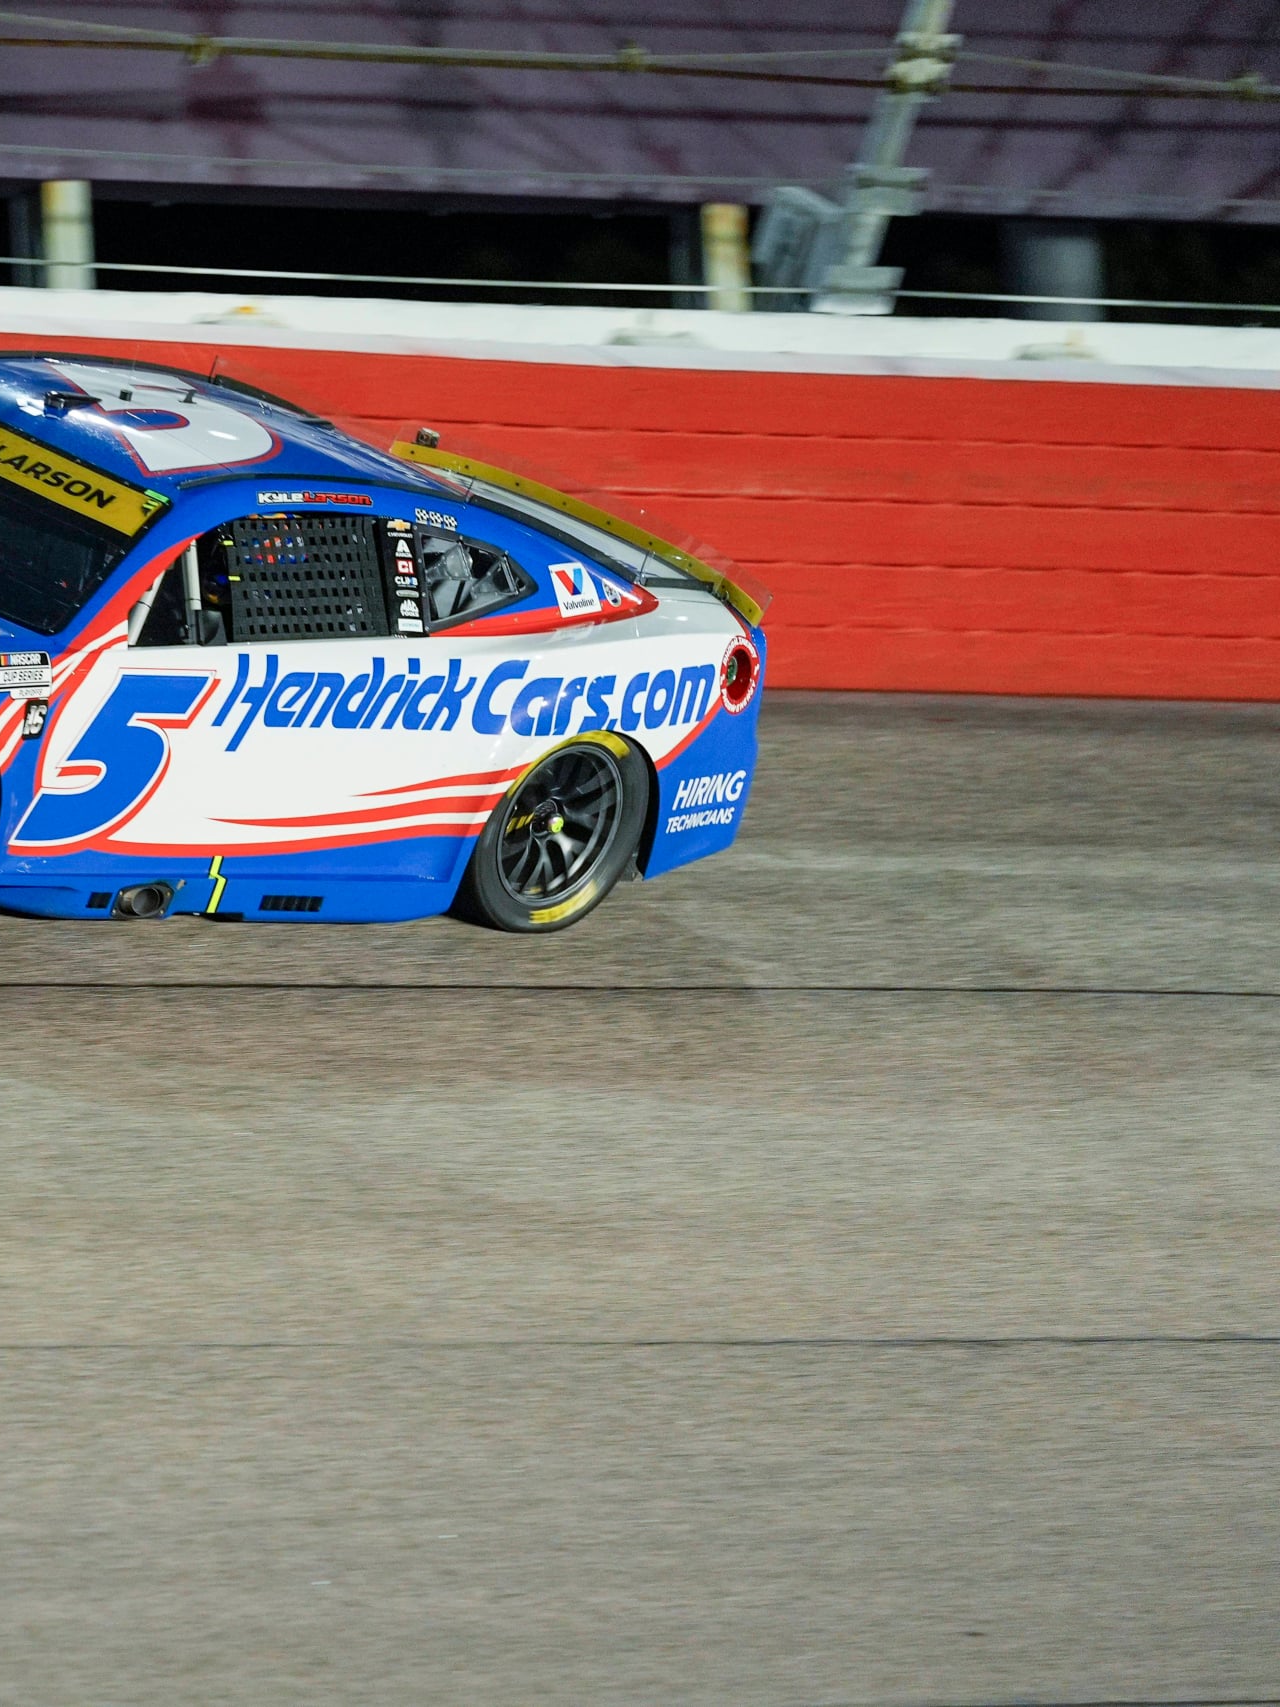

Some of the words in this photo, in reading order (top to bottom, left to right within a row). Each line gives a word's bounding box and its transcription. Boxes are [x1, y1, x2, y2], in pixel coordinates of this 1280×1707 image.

[563, 598, 595, 611] Valvoline
[10, 653, 42, 666] NASCAR
[3, 671, 18, 682] CUP
[19, 670, 44, 681] SERIES
[212, 653, 716, 751] HendrickCars.com
[10, 669, 218, 850] 5
[672, 769, 747, 811] HIRING
[665, 806, 735, 834] TECHNICIANS
